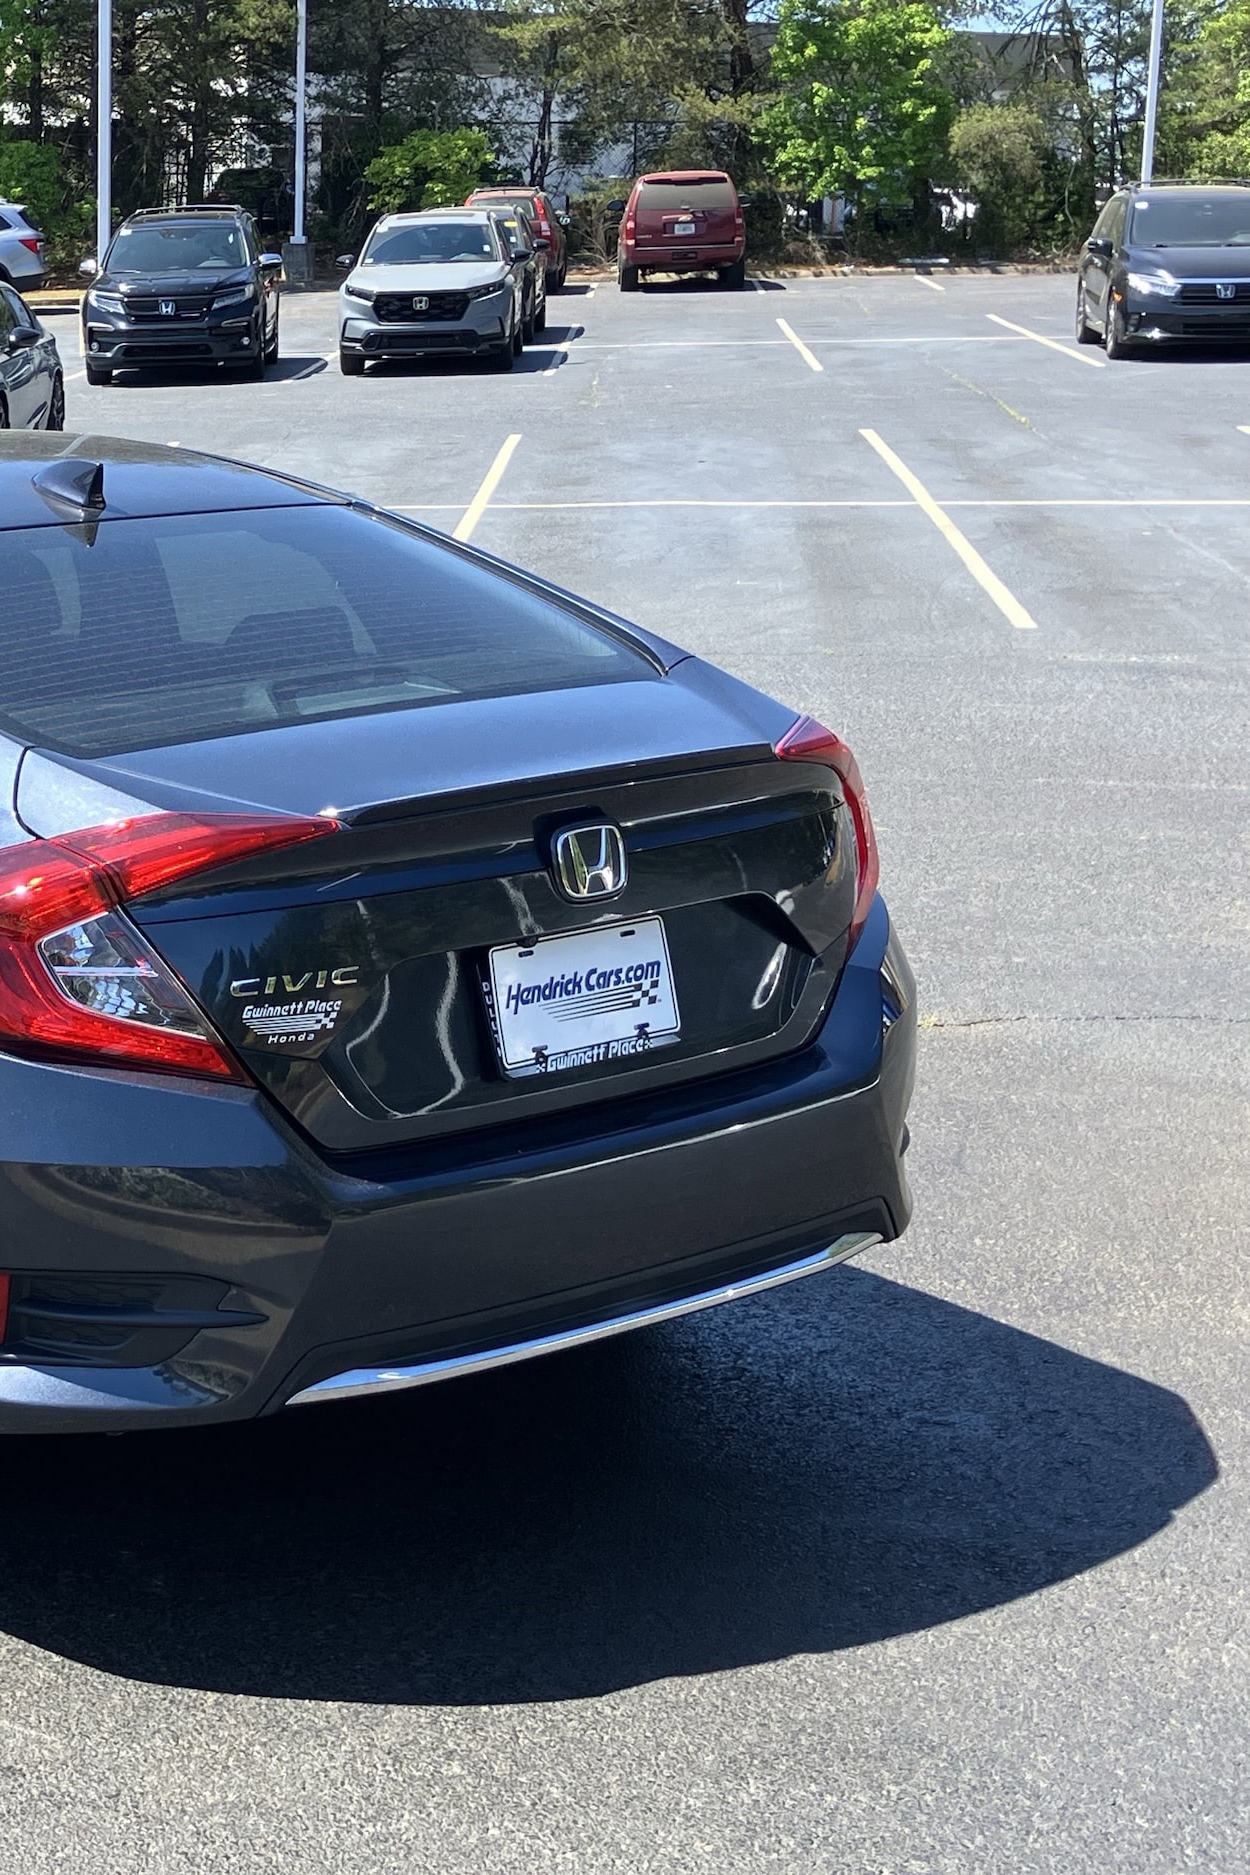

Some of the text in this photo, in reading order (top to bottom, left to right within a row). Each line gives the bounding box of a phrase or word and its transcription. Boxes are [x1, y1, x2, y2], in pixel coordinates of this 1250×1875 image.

[230, 966, 359, 997] CIVIC
[505, 960, 661, 1015] Hendrick Cars.com
[242, 1000, 343, 1018] Gwinnett Place
[268, 1032, 315, 1044] Honda
[547, 1038, 644, 1072] Gwinnett Place
